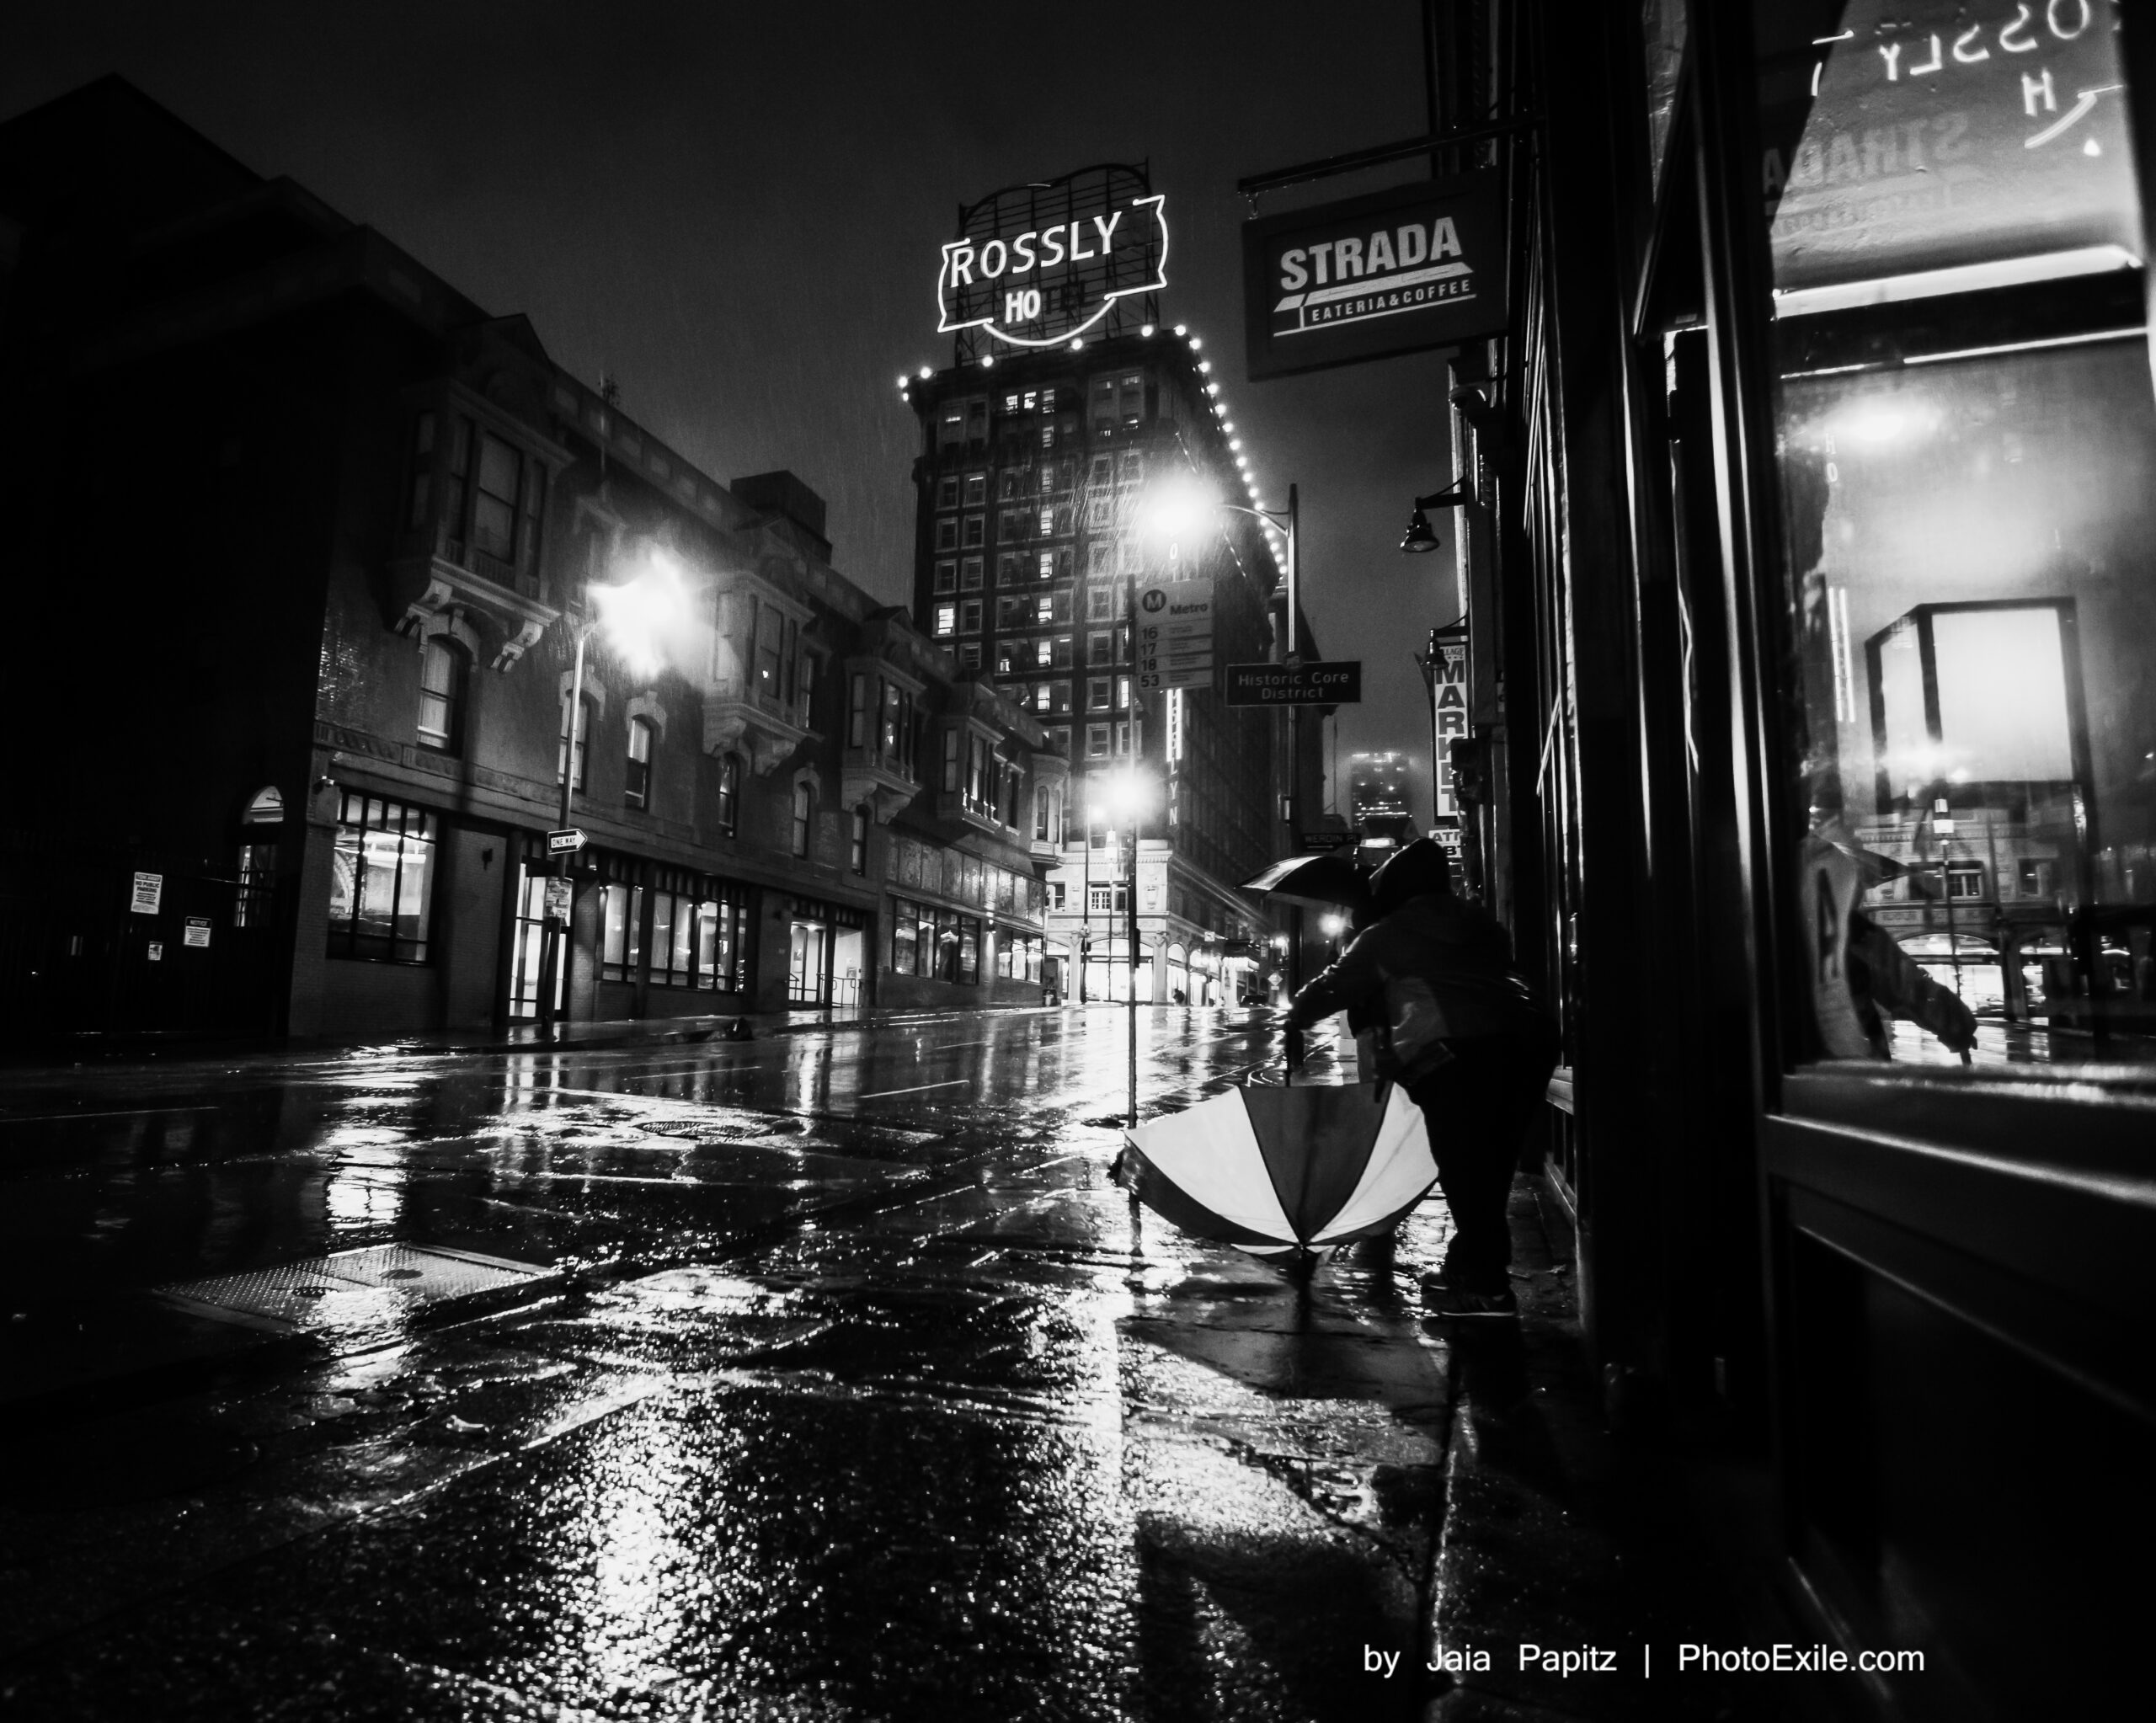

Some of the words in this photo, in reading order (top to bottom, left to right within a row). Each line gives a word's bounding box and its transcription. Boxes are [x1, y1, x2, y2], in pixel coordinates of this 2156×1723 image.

[950, 211, 1122, 288] ROSSLY
[1280, 216, 1462, 291] STRADA
[1311, 279, 1470, 323] EATERIA&COFFEE
[1170, 602, 1209, 616] Metro
[1143, 627, 1158, 640] 16
[1141, 643, 1157, 656] 17
[1142, 659, 1157, 671] 18
[1140, 674, 1160, 688] 53
[1239, 673, 1302, 686] Historic
[1311, 672, 1349, 685] Core
[1262, 687, 1324, 700] District
[552, 838, 563, 847] ONE
[565, 836, 576, 845] WAY
